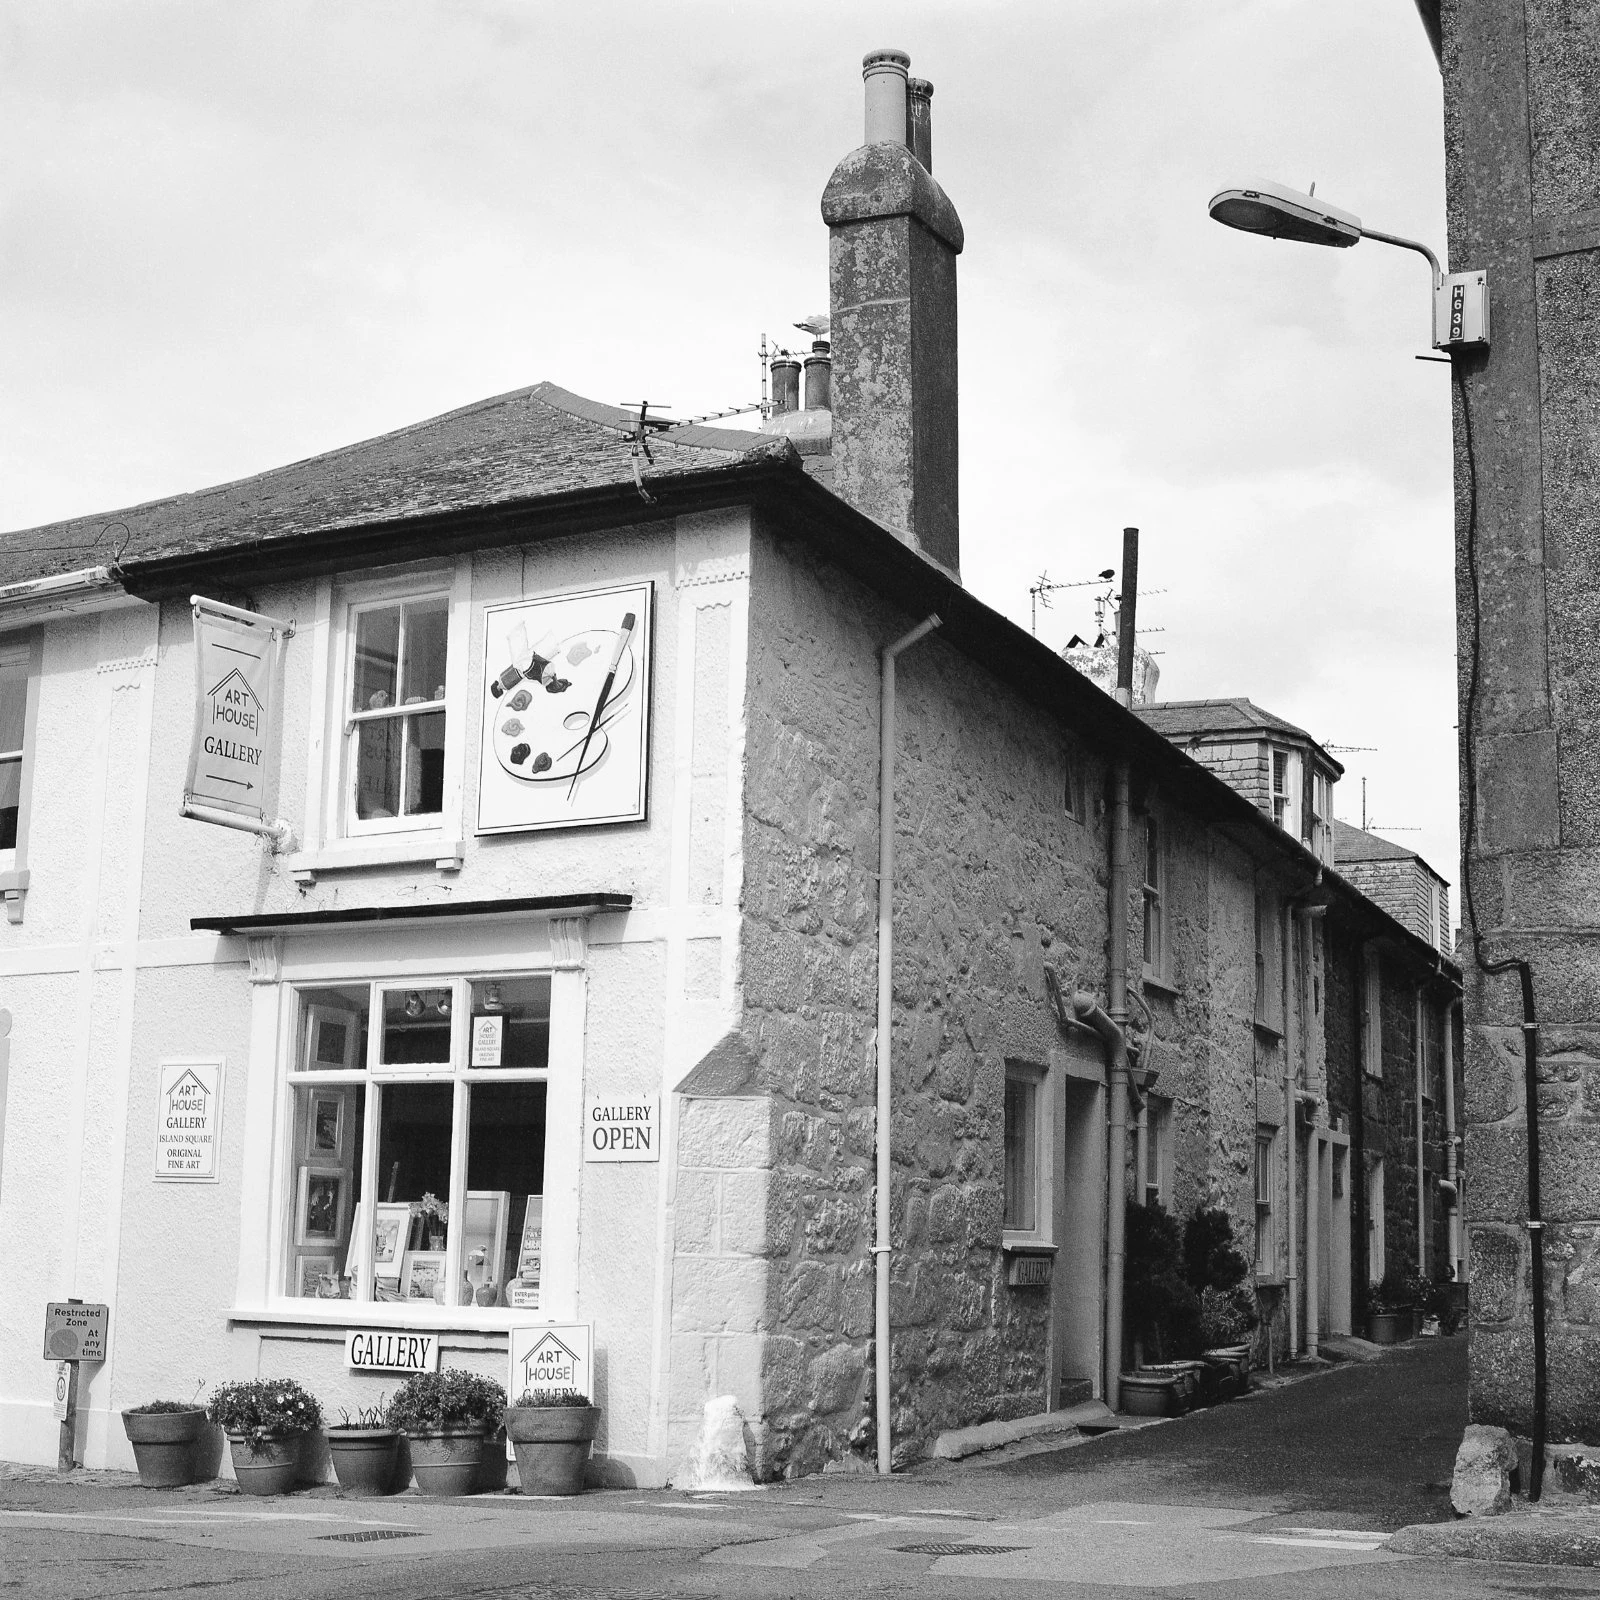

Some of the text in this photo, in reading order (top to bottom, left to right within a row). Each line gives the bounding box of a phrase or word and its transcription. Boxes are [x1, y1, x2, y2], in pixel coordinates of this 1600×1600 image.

[1452, 286, 1463, 337] H639
[225, 689, 249, 707] ART
[216, 704, 255, 730] HOUSE
[204, 736, 262, 766] GALLERY
[179, 1085, 198, 1096] ART
[171, 1099, 203, 1111] HOUSE
[592, 1106, 652, 1122] GALLERY
[166, 1117, 207, 1129] GALLERY
[159, 1134, 213, 1145] ISLAND SQUARE
[592, 1127, 652, 1151] OPEN
[166, 1148, 203, 1158] ORIGINAL
[167, 1160, 201, 1169] FINE ART
[54, 1308, 101, 1317] Restricted
[65, 1318, 88, 1327] Zone
[87, 1329, 98, 1338] At
[84, 1340, 100, 1348] any
[81, 1348, 102, 1357] time
[351, 1333, 432, 1369] GALLERY
[536, 1350, 563, 1364] ART
[528, 1366, 571, 1381] HOUSE
